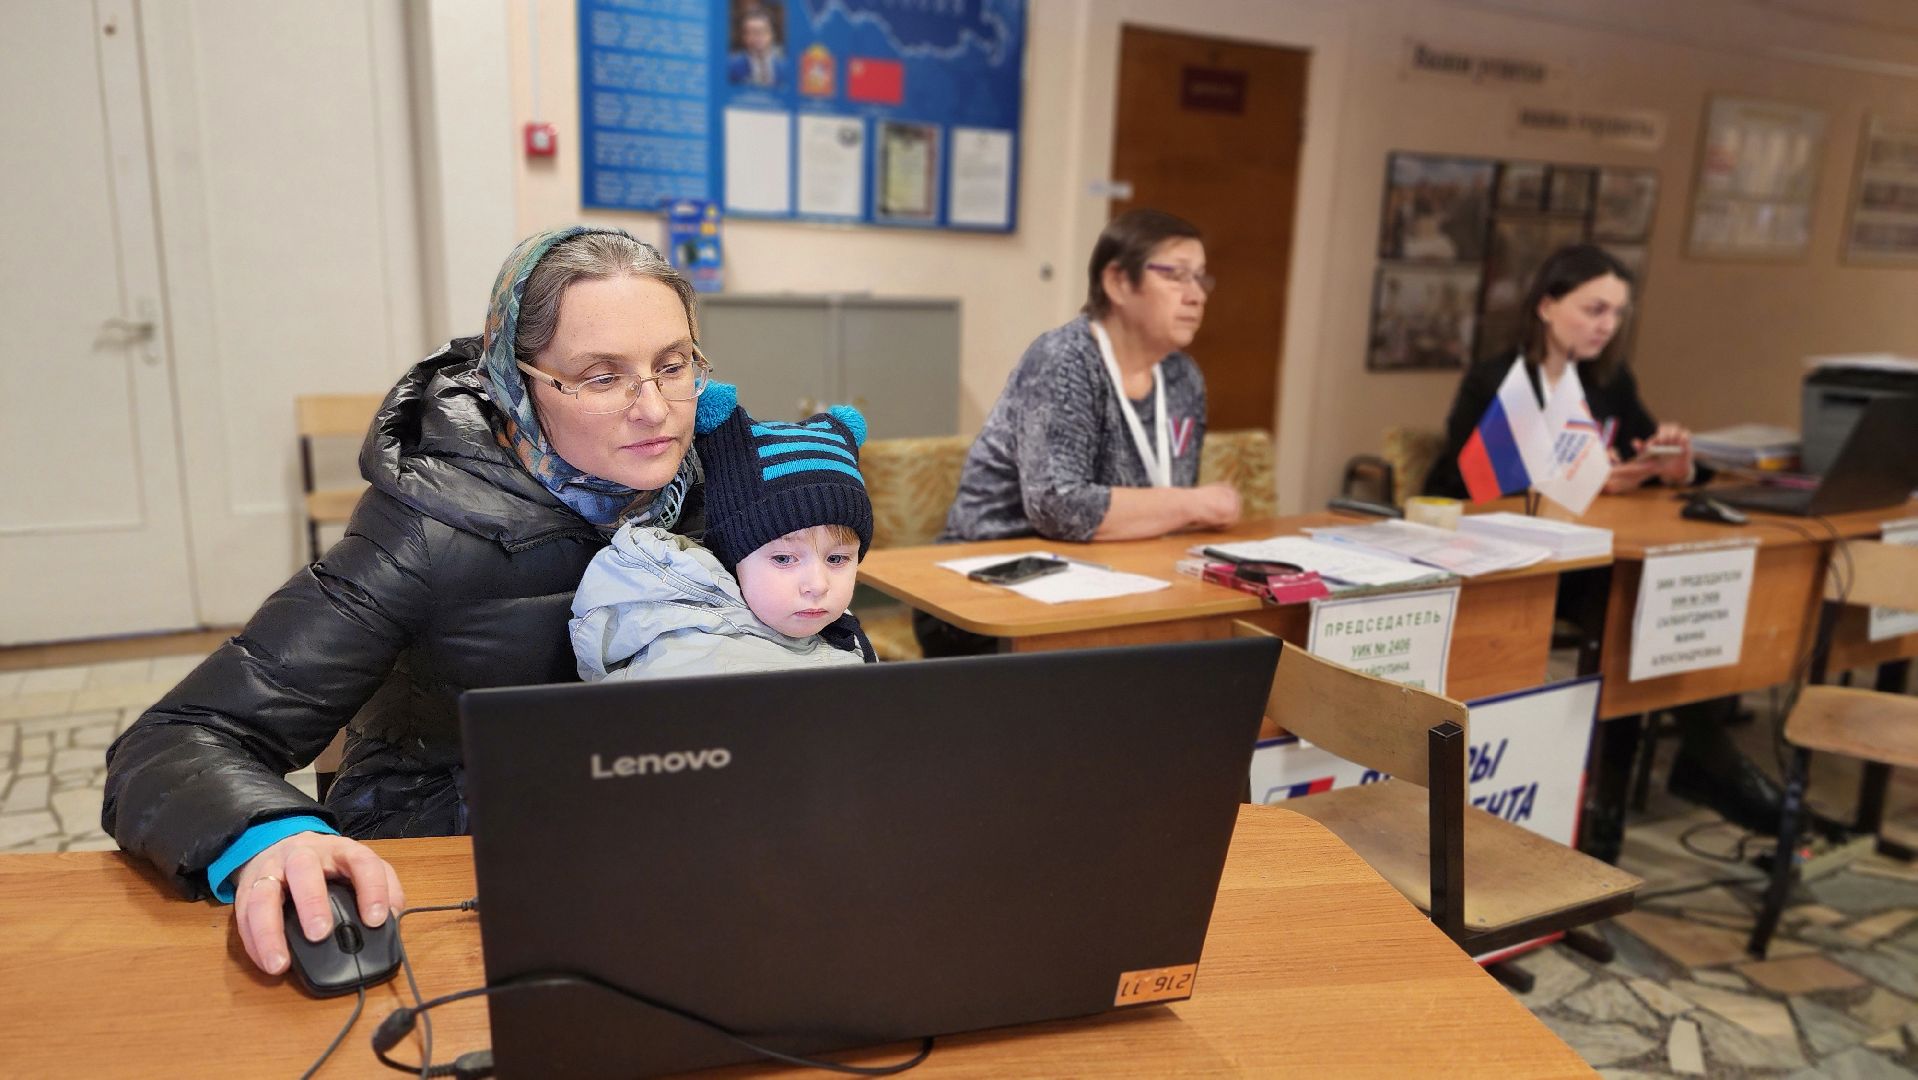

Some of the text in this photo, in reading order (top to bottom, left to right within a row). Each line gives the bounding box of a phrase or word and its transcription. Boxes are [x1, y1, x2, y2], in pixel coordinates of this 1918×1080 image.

[1323, 610, 1441, 637] ПРЕДСЕДАТЕЛЬ
[1351, 642, 1372, 658] УИК
[590, 748, 732, 780] Lenovo
